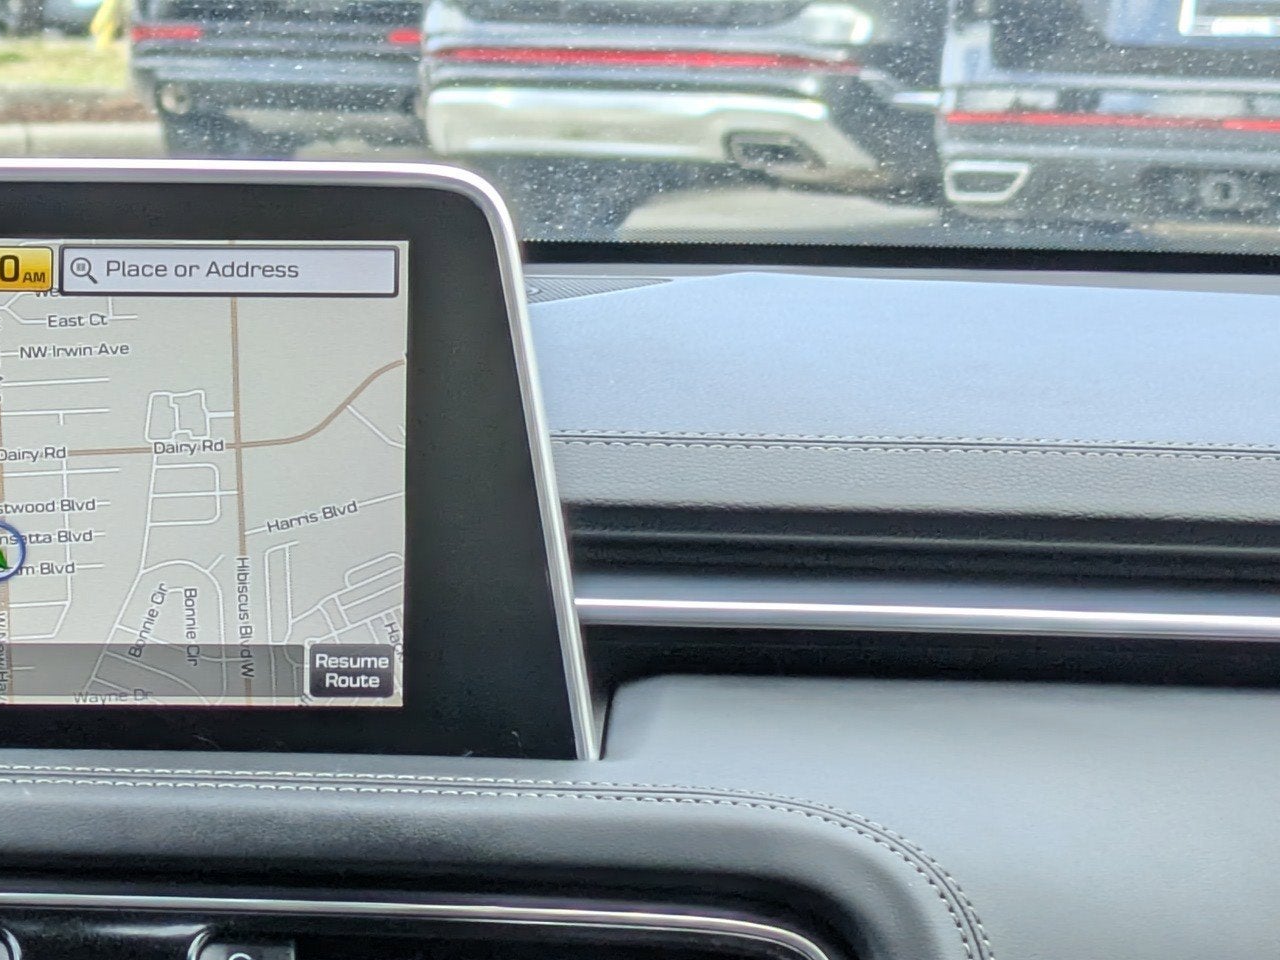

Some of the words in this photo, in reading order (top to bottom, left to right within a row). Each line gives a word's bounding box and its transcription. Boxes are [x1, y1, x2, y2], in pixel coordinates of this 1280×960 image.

[23, 272, 46, 283] AM
[106, 260, 168, 278] Place
[174, 262, 200, 278] or
[206, 260, 300, 279] Address
[48, 315, 84, 328] East
[89, 313, 107, 326] Ct
[20, 346, 47, 359] NW
[53, 345, 92, 357] Irwin
[98, 343, 129, 356] Ave
[44, 446, 66, 459] Rd
[153, 440, 200, 456] Dairy
[203, 439, 225, 453] Rd
[61, 498, 96, 511] Blvd
[267, 512, 319, 533] Harris
[323, 501, 358, 518] Blvd
[58, 530, 93, 543] Blvd
[40, 562, 75, 575] Blvd
[237, 557, 250, 620] Hibiscus
[129, 608, 159, 658] Bonnie
[151, 583, 169, 605] Cir
[184, 588, 199, 640] Bonnie
[239, 626, 253, 659] Blvd
[186, 645, 200, 667] Cir
[315, 653, 389, 669] Resume
[241, 664, 255, 678] W
[325, 672, 380, 688] Route
